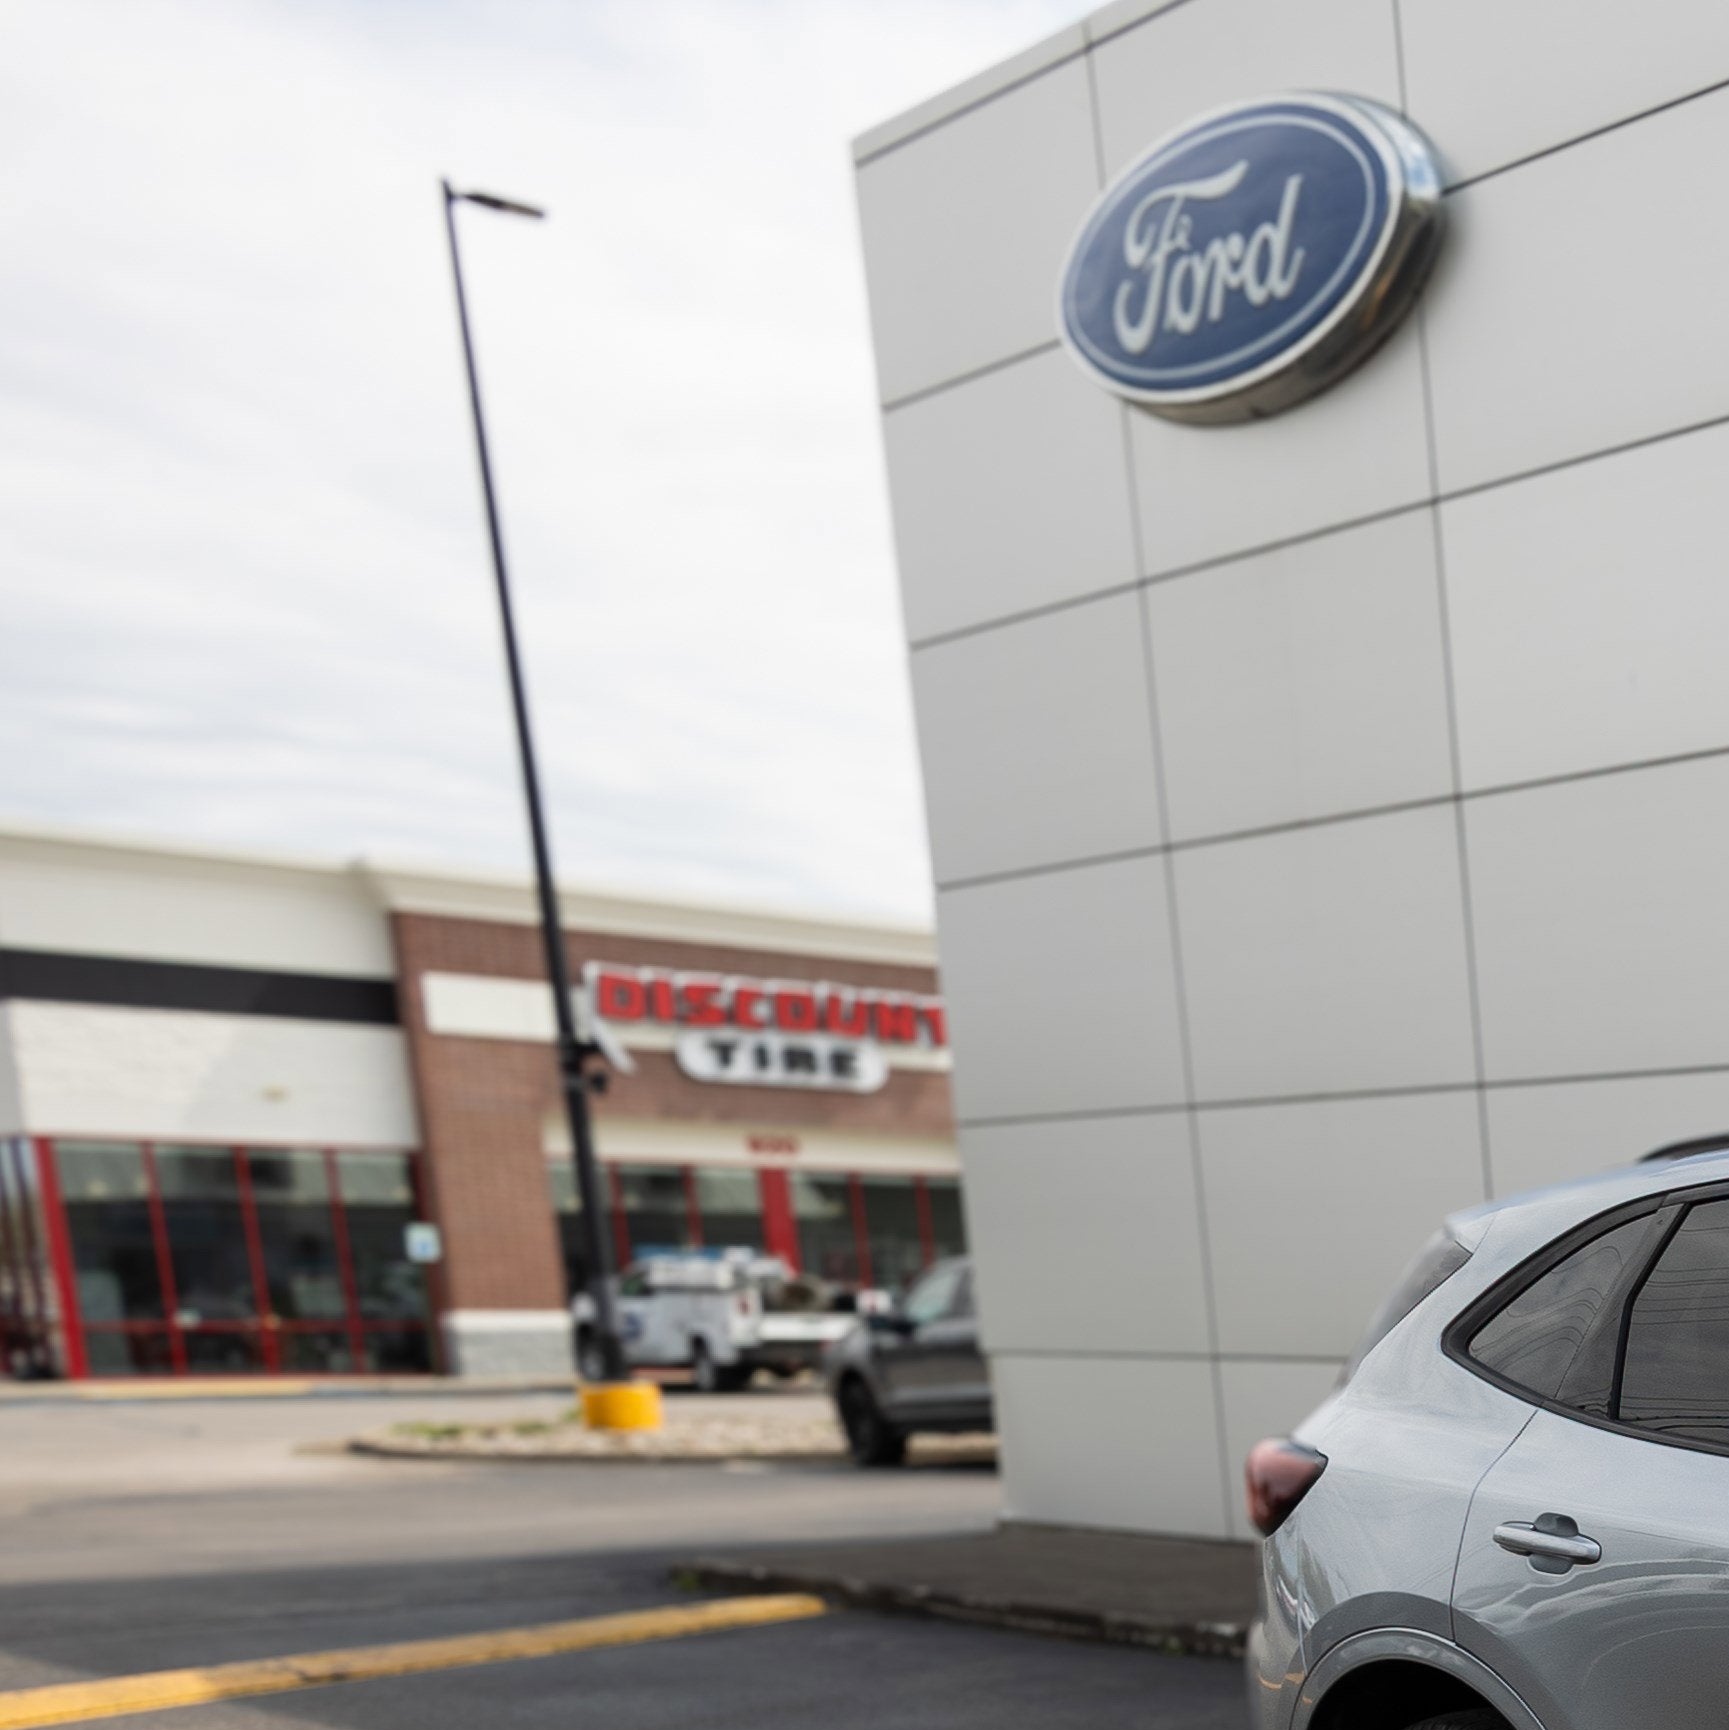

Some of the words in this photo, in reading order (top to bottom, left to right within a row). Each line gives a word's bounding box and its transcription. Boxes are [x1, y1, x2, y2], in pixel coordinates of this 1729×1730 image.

[1112, 159, 1306, 354] Ford
[597, 968, 947, 1047] DISCOUNT
[705, 1039, 859, 1078] TIRE
